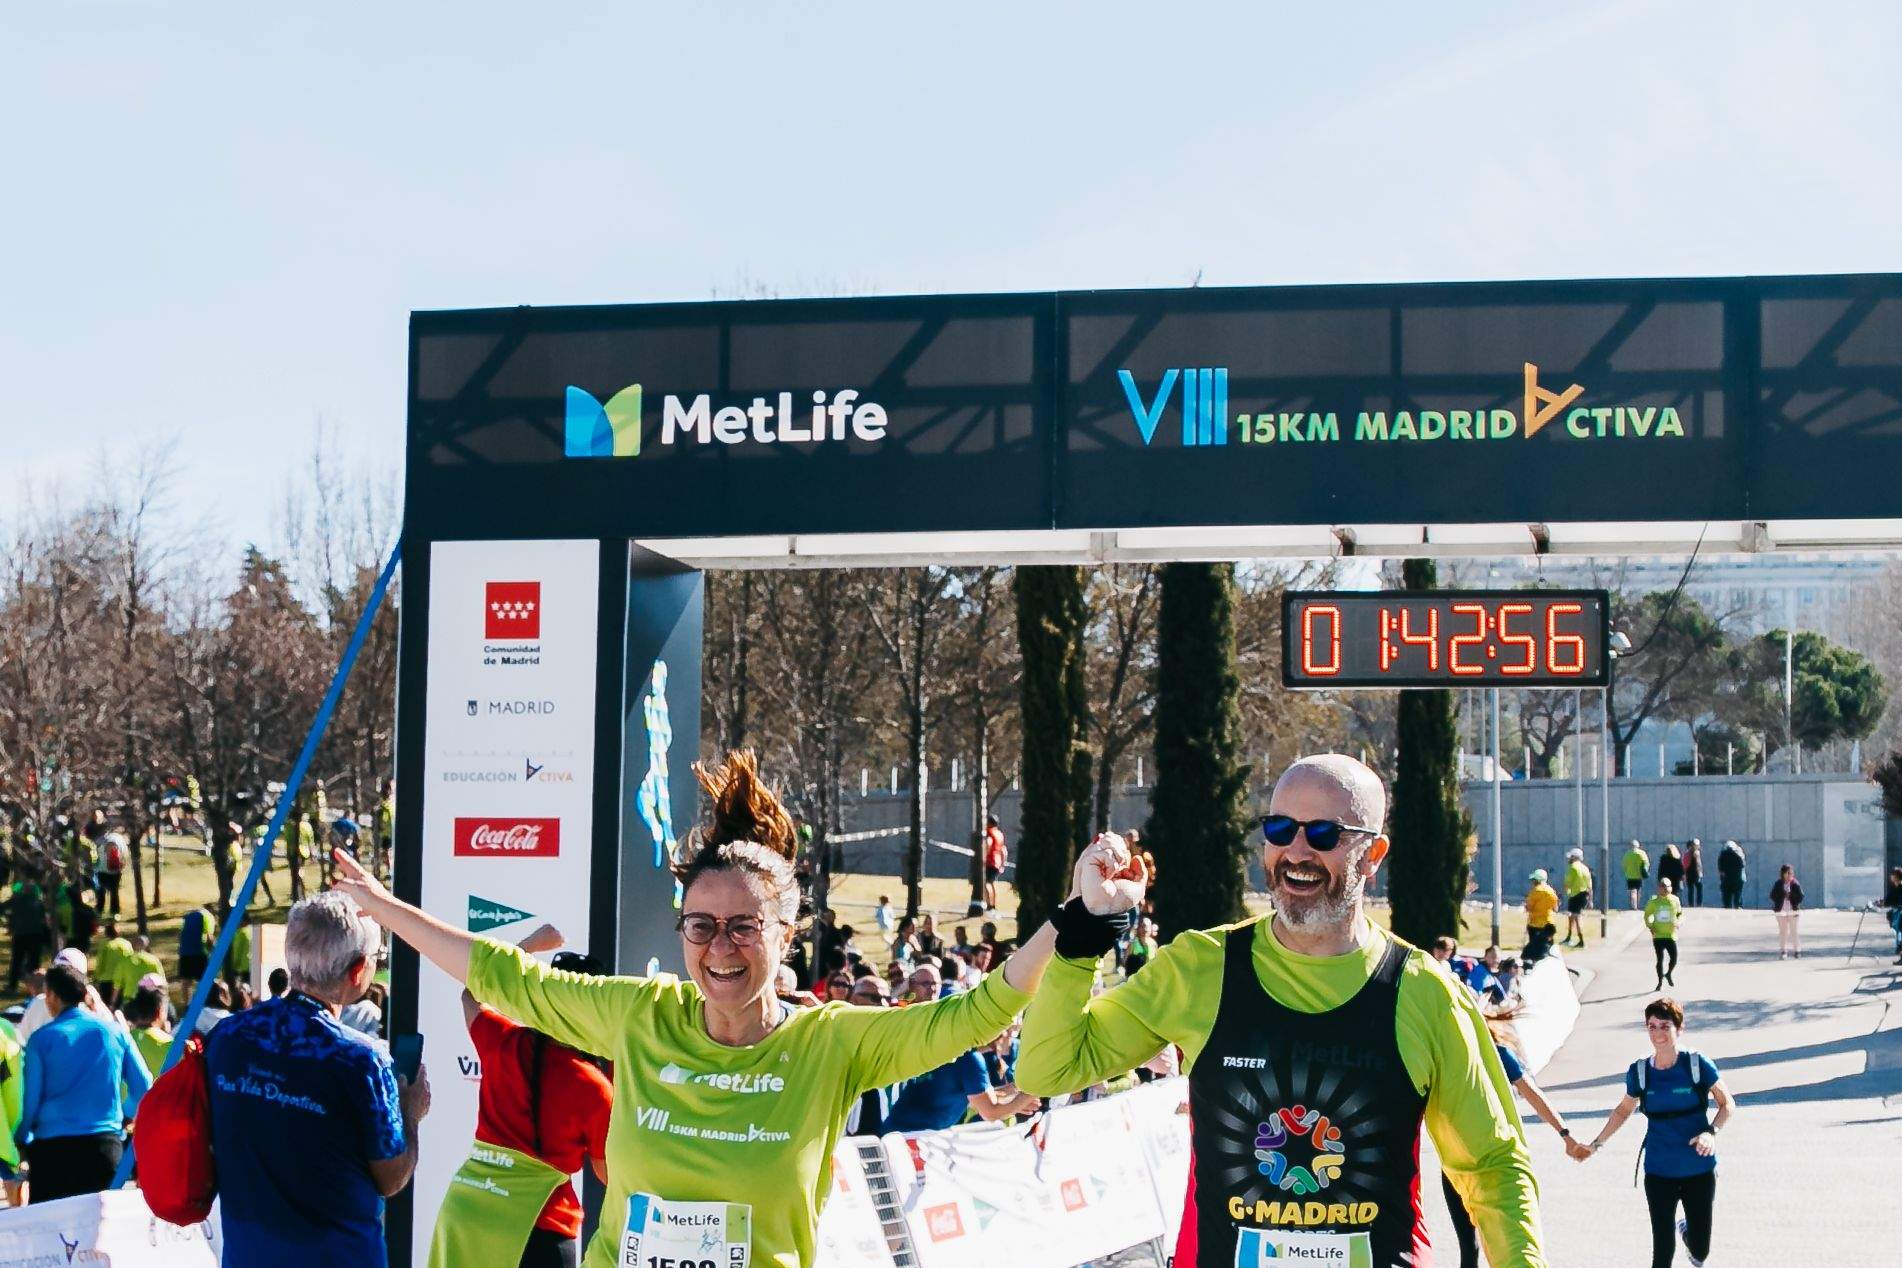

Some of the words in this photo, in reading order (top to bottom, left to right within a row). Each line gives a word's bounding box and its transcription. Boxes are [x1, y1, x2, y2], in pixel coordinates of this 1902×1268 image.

[1117, 366, 1228, 446] VIII
[1236, 412, 1340, 443] 15KM
[1354, 409, 1517, 441] MADRID
[661, 390, 888, 445] MetLife
[483, 645, 541, 653] Comunidad
[483, 657, 496, 665] de
[501, 657, 540, 665] Madrid
[489, 701, 555, 714] MADRID
[1223, 1056, 1266, 1069] FASTER
[694, 1072, 784, 1093] MetLife
[636, 1105, 670, 1132] VIII
[669, 1123, 698, 1138] 15KM
[701, 1129, 747, 1142] MADRID
[667, 1213, 720, 1227] MetLife
[1288, 1246, 1344, 1259] MetLife
